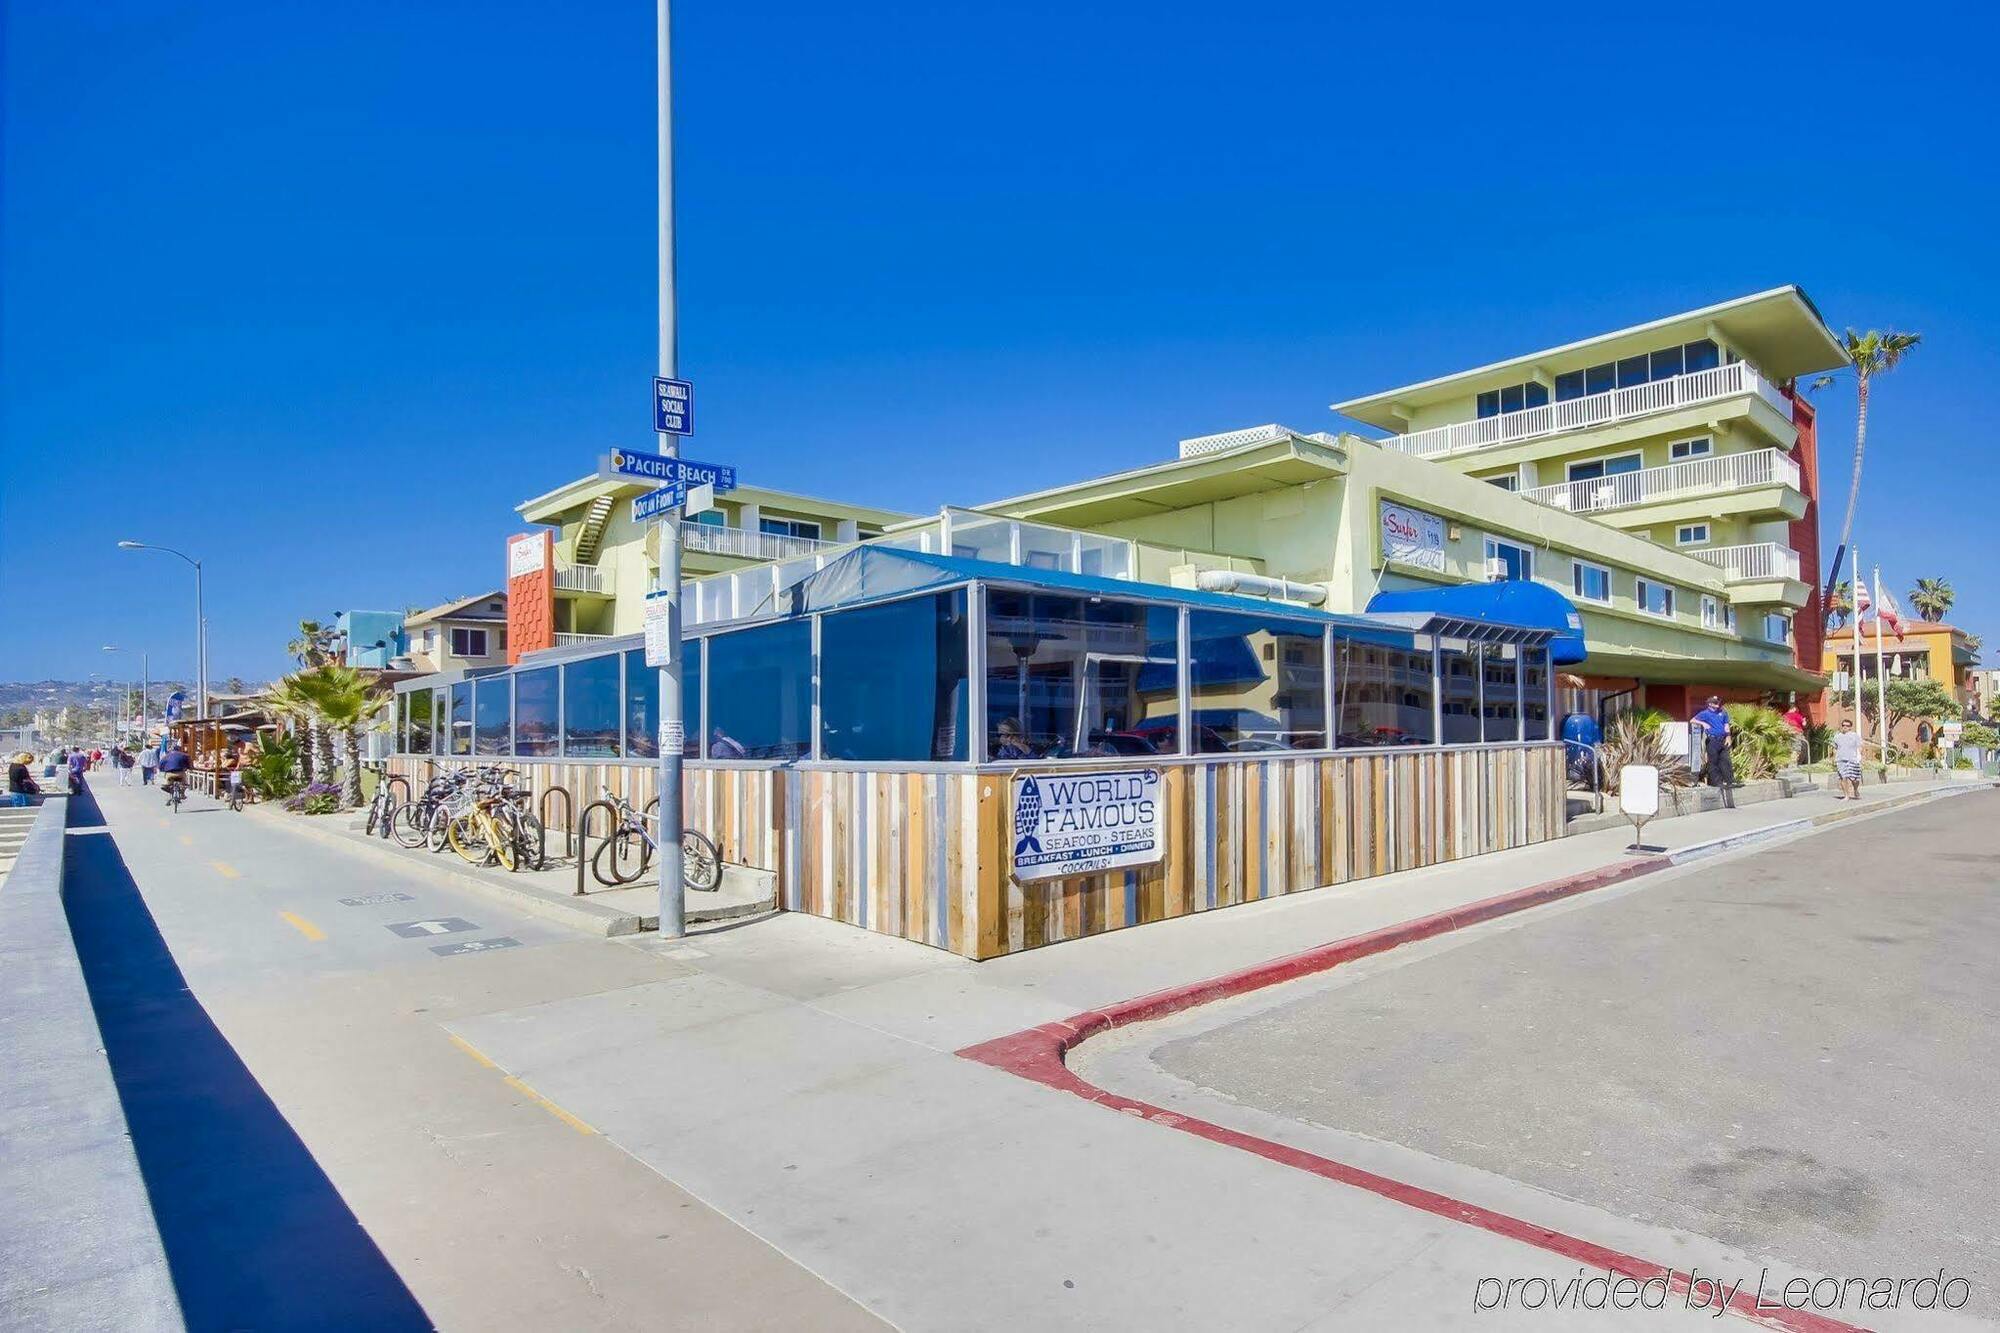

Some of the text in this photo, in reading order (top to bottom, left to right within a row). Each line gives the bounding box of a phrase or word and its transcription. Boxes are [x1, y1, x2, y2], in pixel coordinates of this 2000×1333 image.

[658, 383, 688, 400] SEAWALL
[662, 399, 686, 415] SOCIAL
[665, 414, 683, 429] CLUB
[626, 454, 716, 484] PACIFIC BEACH
[656, 490, 674, 512] FRONT
[1388, 513, 1419, 542] Surfer
[1049, 777, 1143, 805] WORLD
[1043, 800, 1155, 833] FAMOUS
[1046, 827, 1155, 850] SEAFOOD STEAKS
[1017, 841, 1153, 866] BREAKFAST LUNCH DINNER
